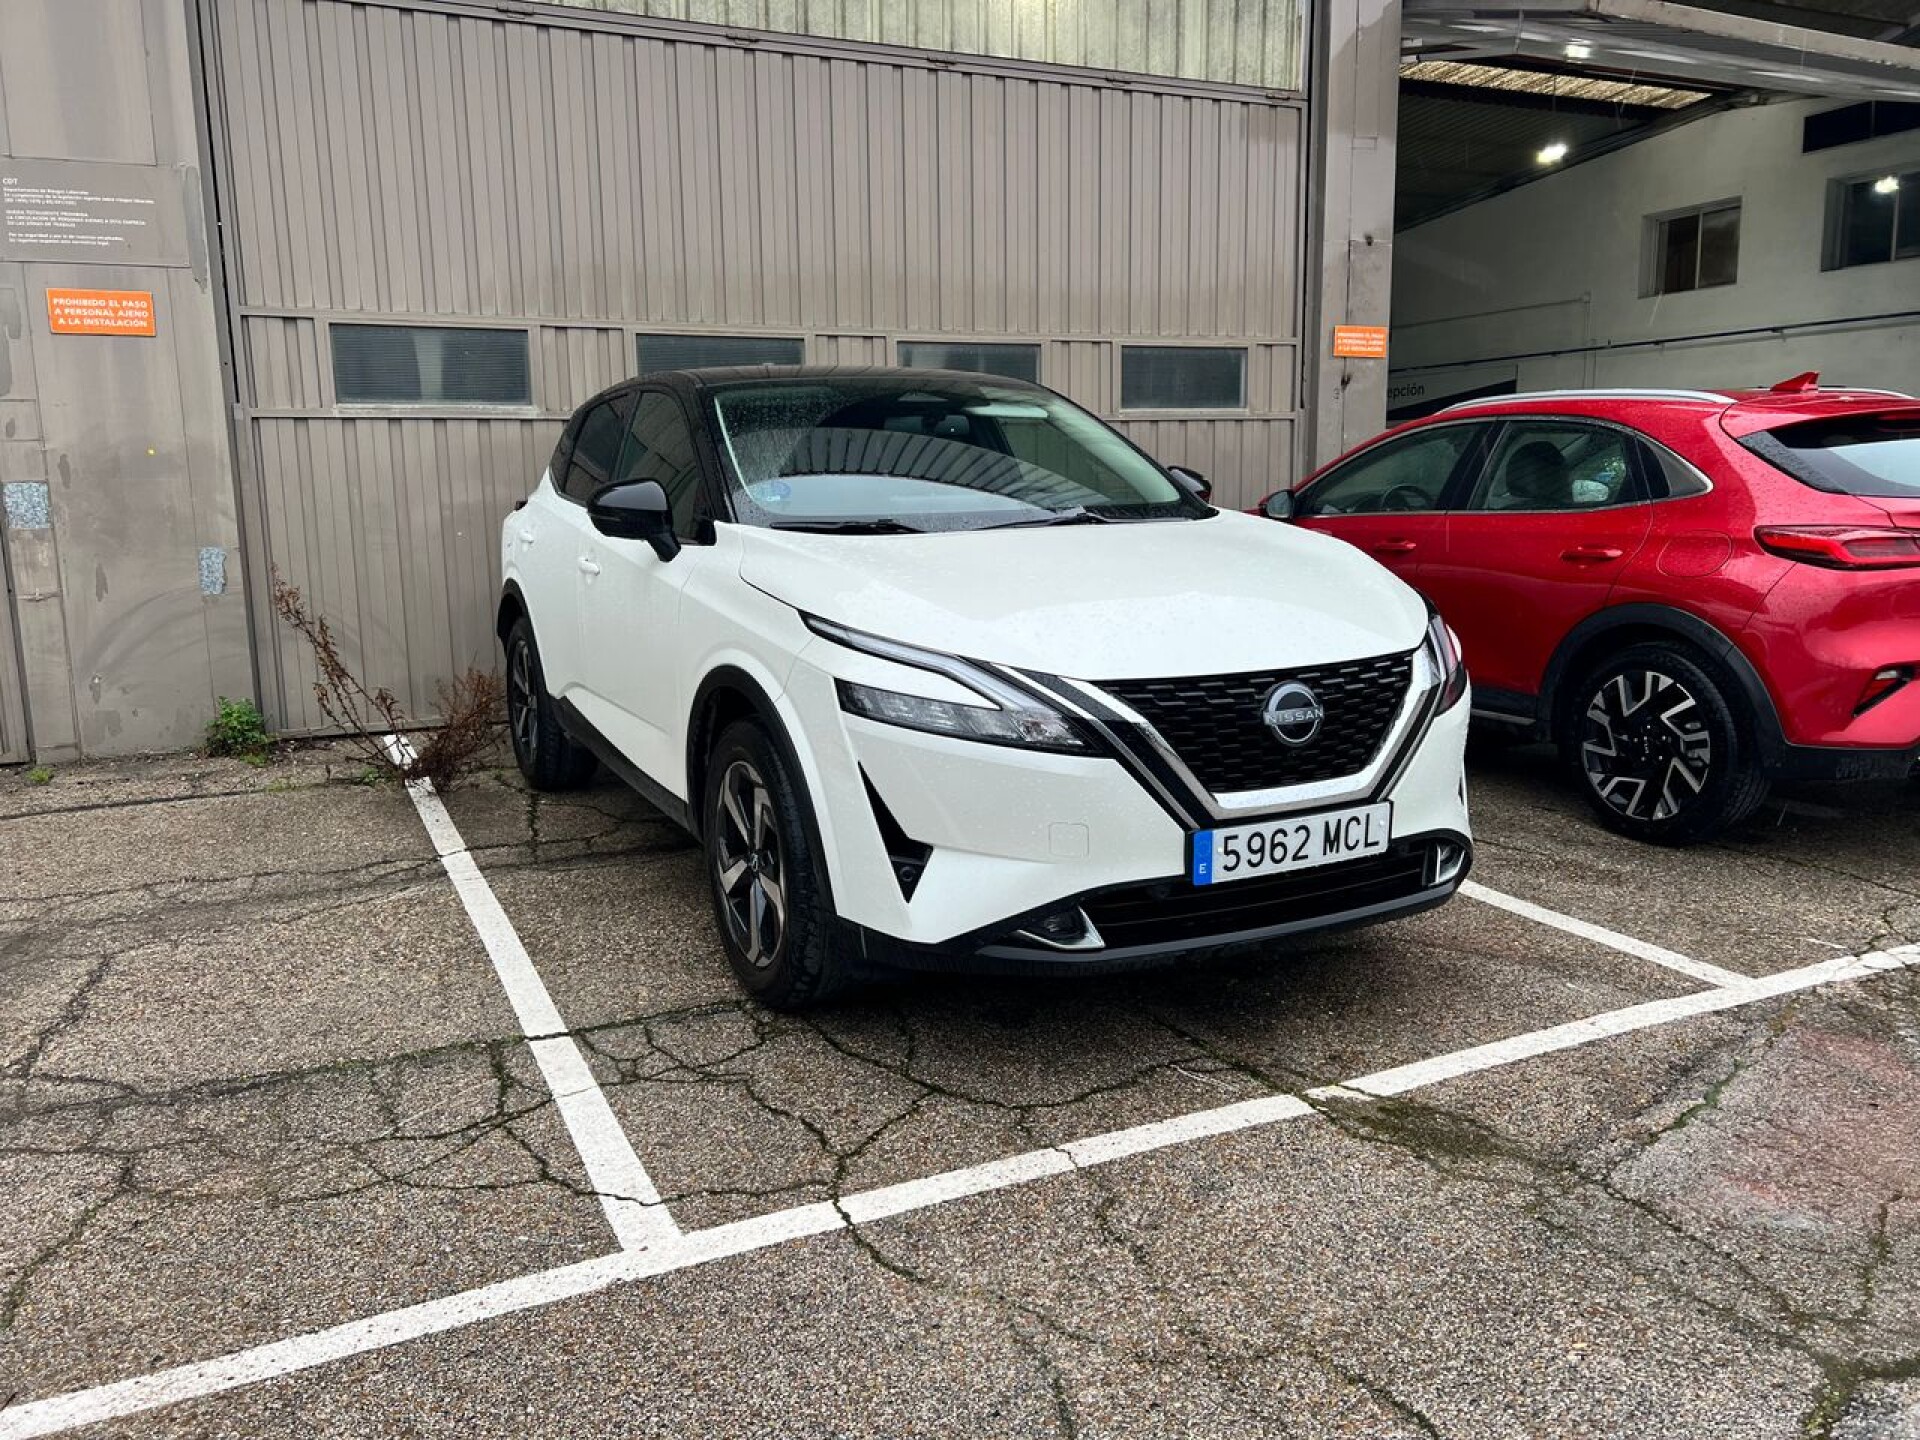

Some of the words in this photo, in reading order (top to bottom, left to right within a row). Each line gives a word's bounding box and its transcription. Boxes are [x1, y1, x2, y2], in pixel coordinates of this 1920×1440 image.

[53, 298, 106, 307] PROHIBIDO
[64, 308, 115, 316] PERSONAL
[118, 310, 149, 318] AJENO
[84, 317, 148, 328] INSTALACIÓN
[1266, 708, 1324, 723] NISSAN
[1222, 824, 1311, 872] 5962
[1323, 813, 1380, 856] MCL
[1199, 863, 1207, 874] E
